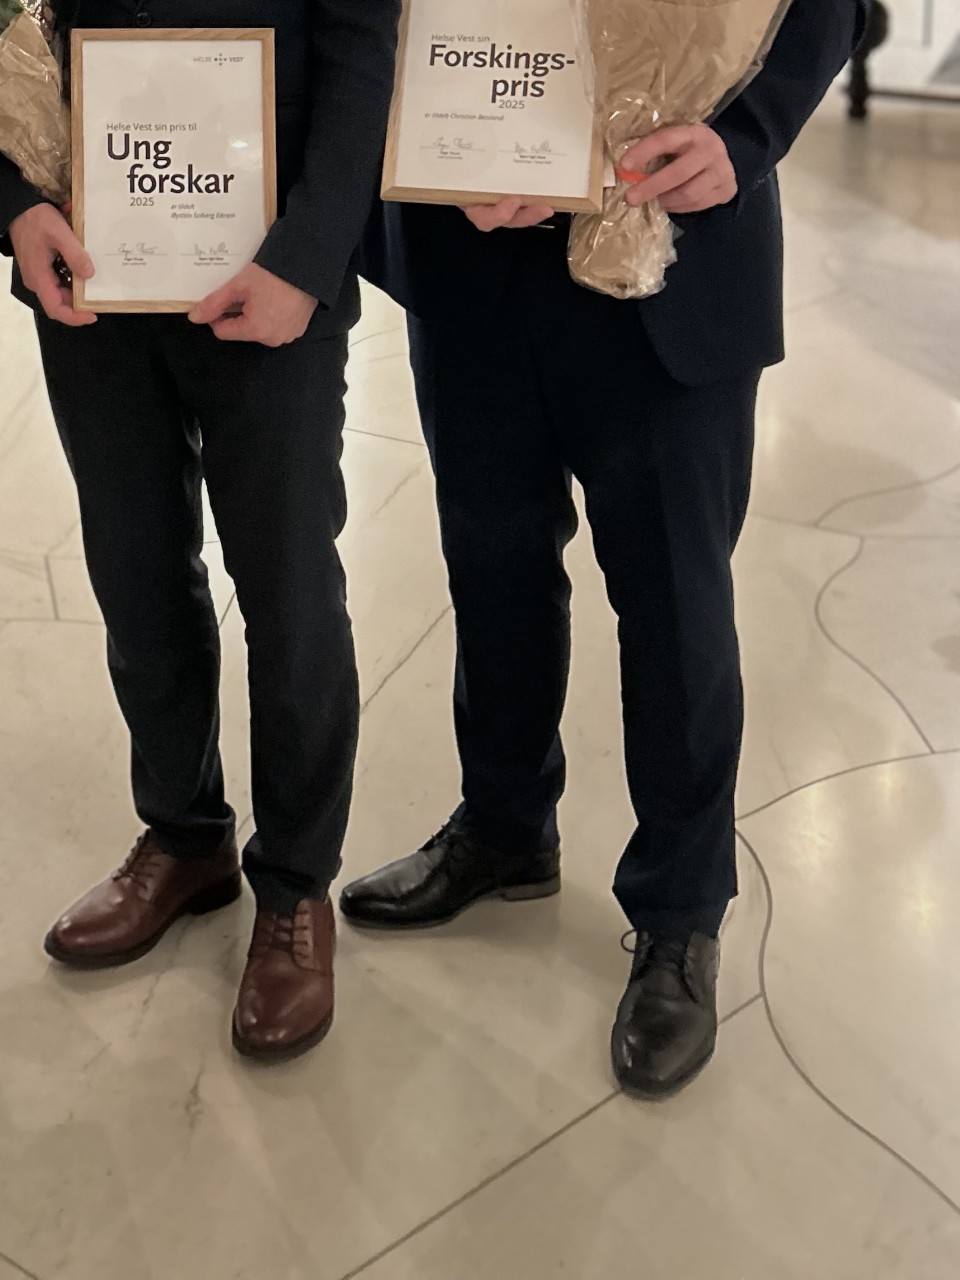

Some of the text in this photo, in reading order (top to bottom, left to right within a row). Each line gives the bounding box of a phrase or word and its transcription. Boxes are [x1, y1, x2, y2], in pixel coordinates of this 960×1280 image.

[431, 34, 490, 43] Helse Vest sin
[429, 43, 575, 77] Forskings-
[491, 72, 546, 104] pris
[498, 100, 525, 109] 2025
[106, 122, 197, 133] Helse Vest sin pris til
[107, 133, 172, 169] Ung
[126, 163, 235, 193] forskar
[129, 197, 155, 207] 2025
